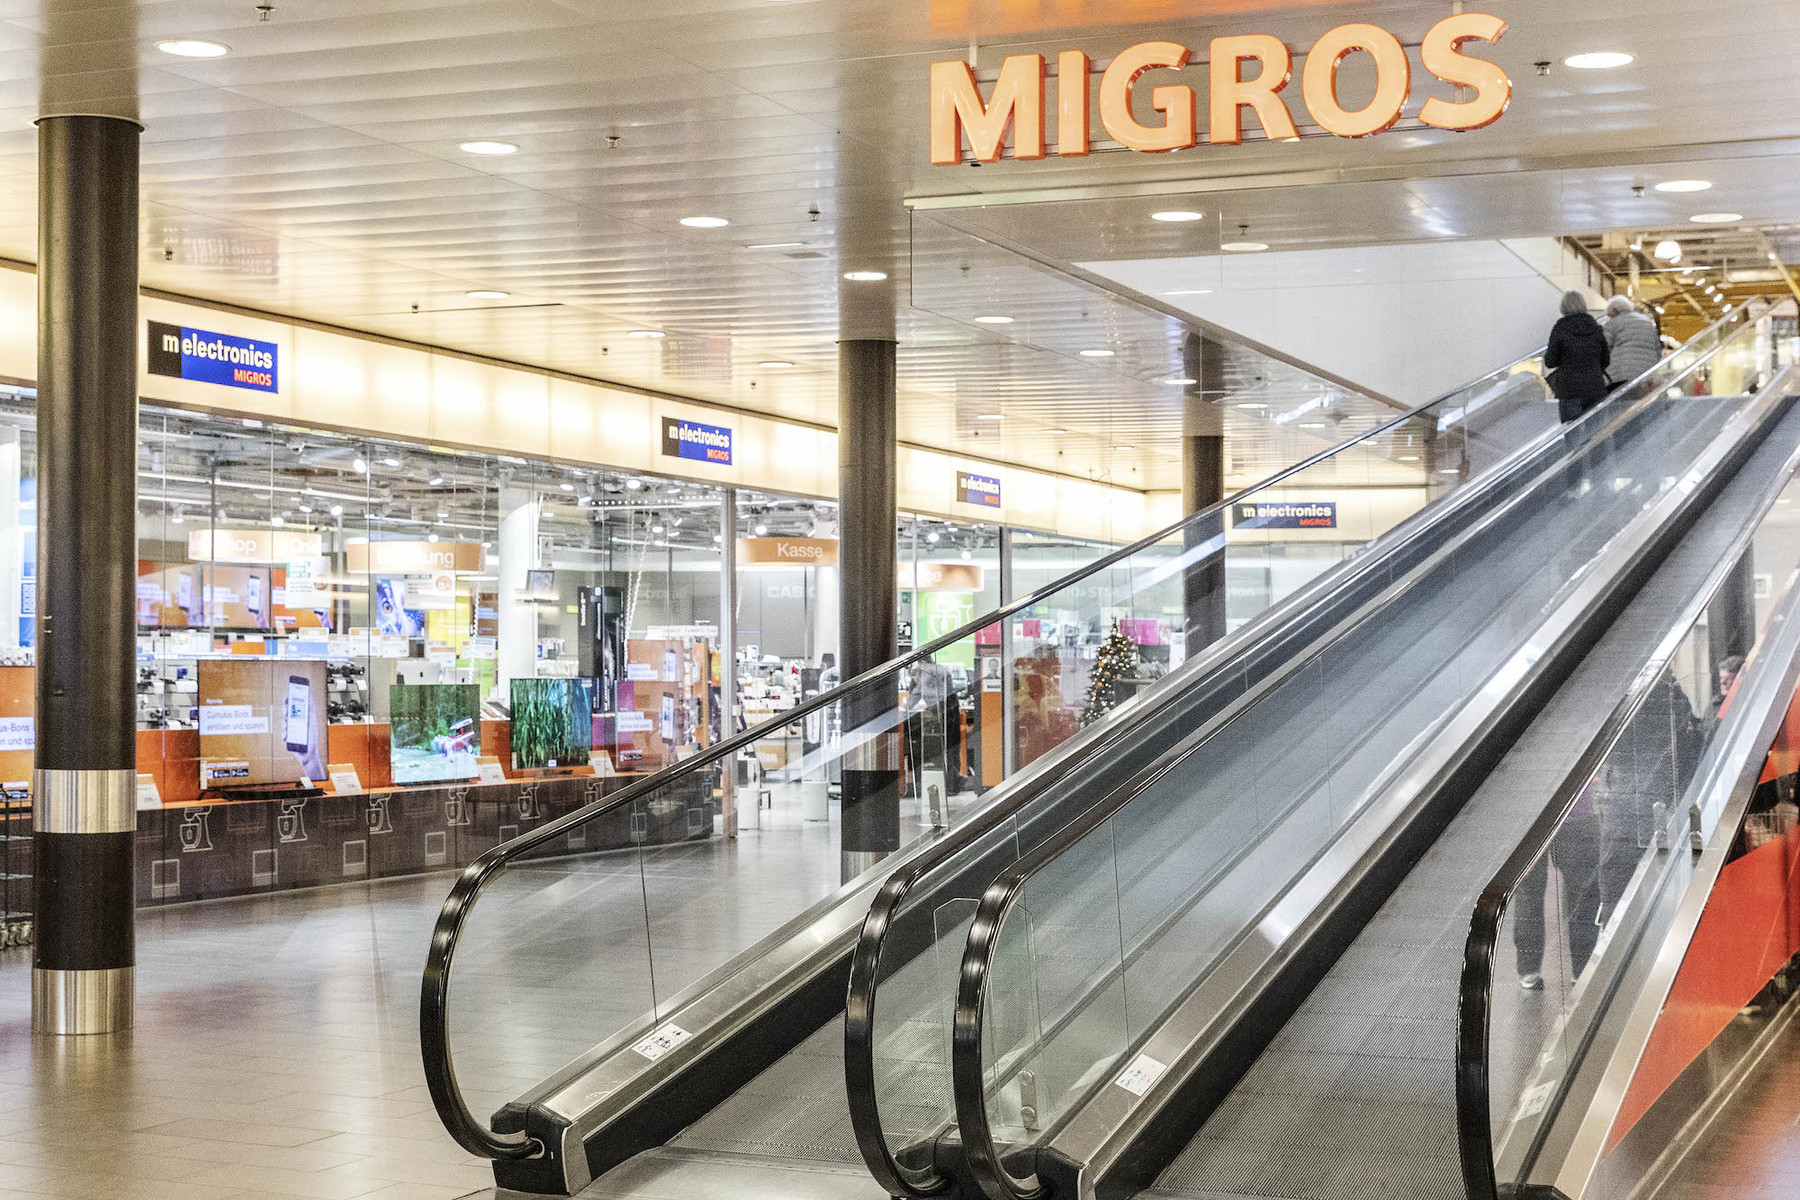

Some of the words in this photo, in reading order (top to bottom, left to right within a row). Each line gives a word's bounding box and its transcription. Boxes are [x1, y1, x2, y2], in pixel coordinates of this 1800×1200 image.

[930, 13, 1513, 166] MIGROS
[233, 368, 272, 387] MIGROS
[706, 447, 729, 461] MIGROS
[1299, 518, 1332, 526] MIGROS
[777, 542, 823, 558] Kasse
